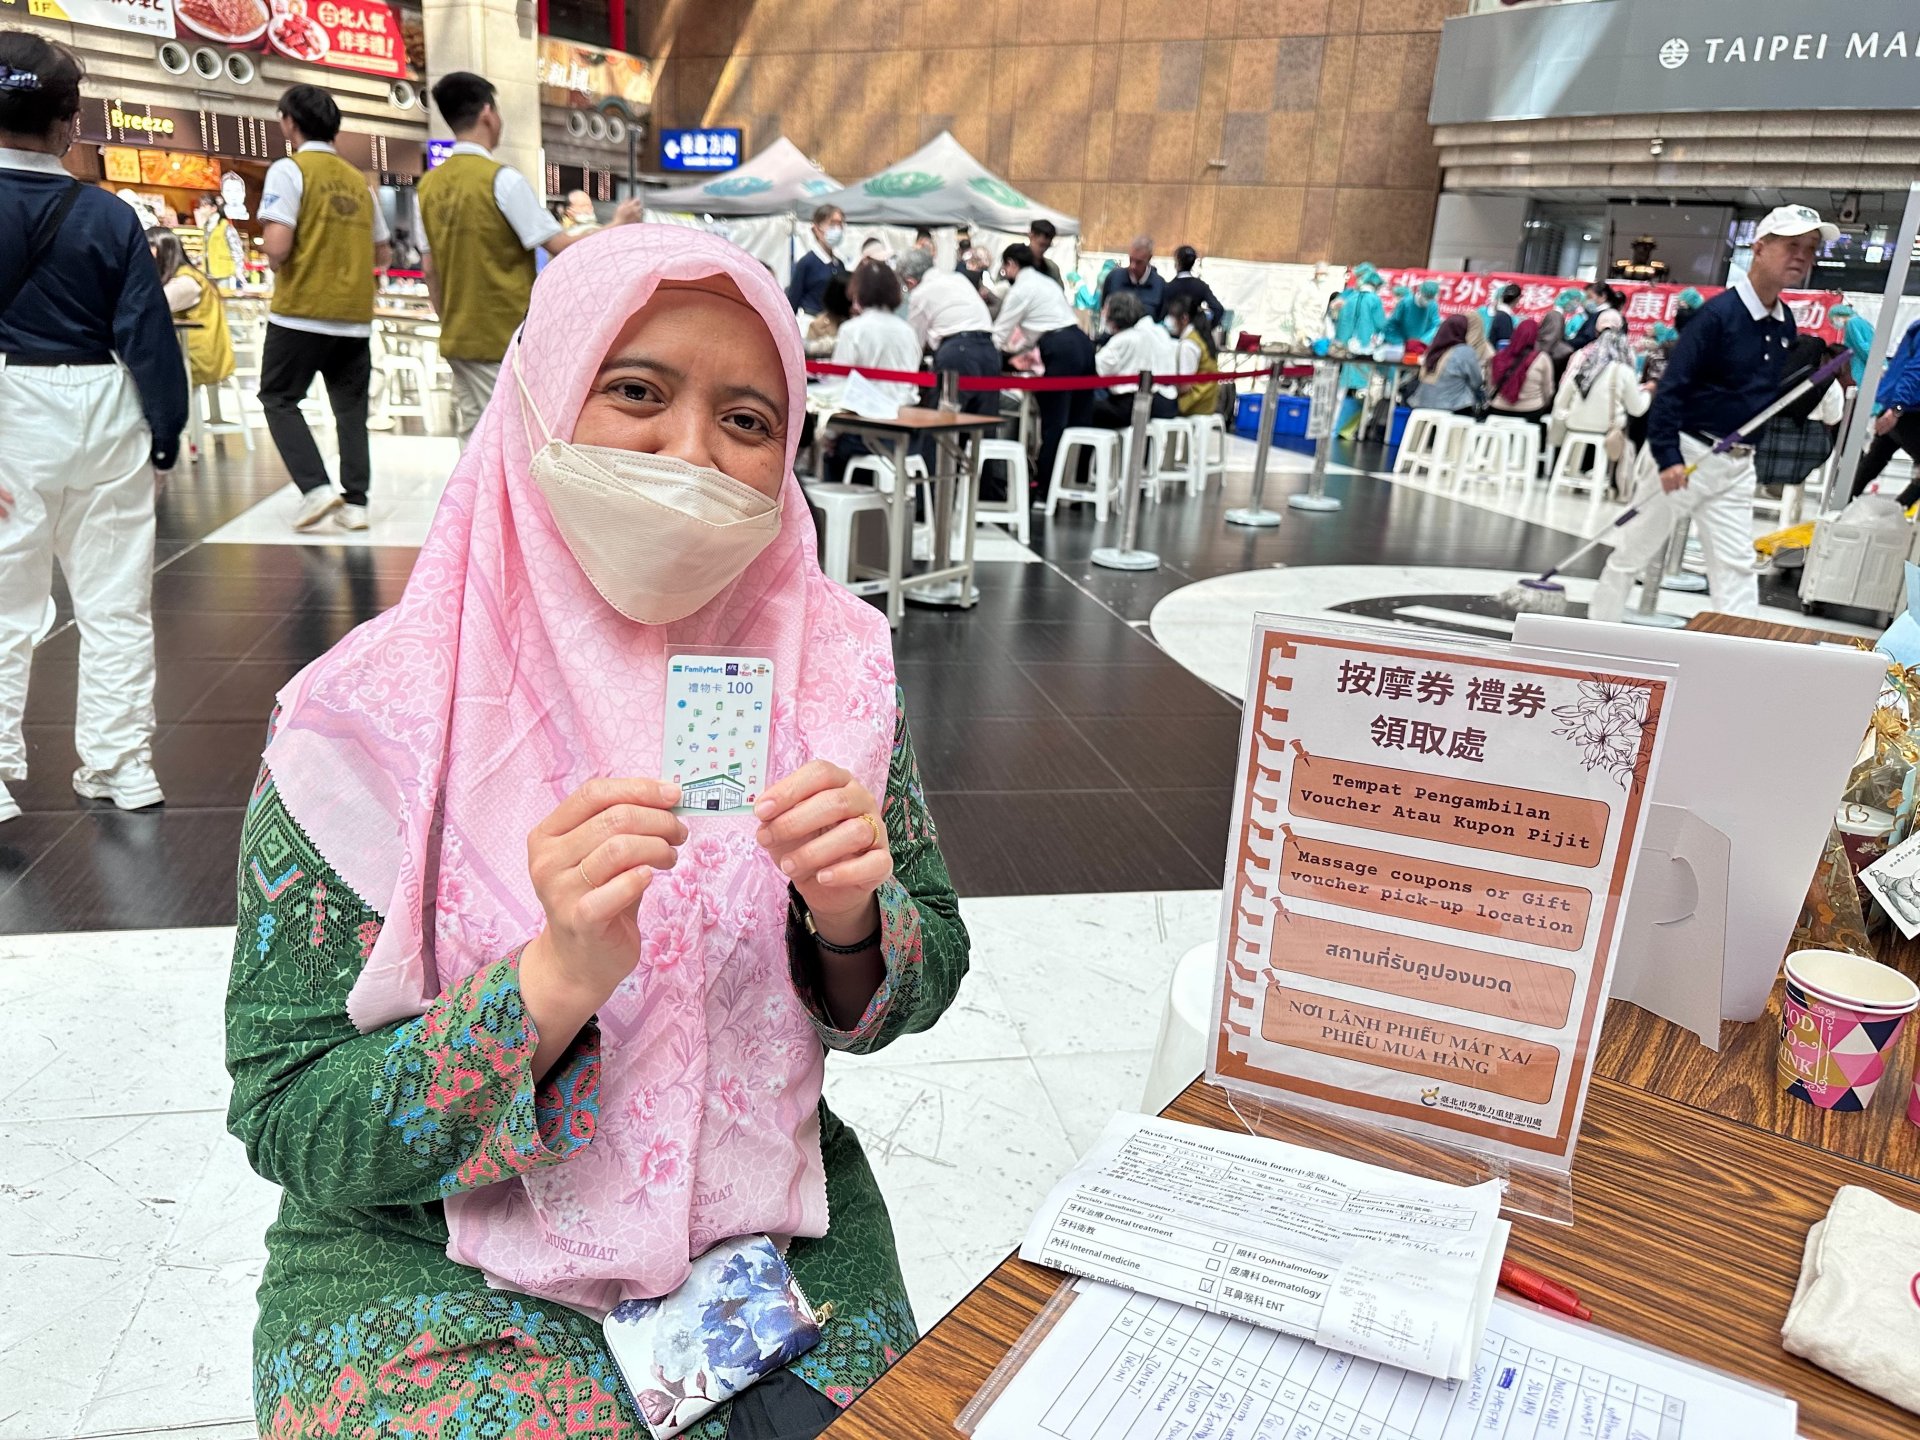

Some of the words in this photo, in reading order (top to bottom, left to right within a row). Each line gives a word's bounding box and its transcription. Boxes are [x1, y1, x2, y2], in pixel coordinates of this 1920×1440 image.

[1704, 33, 1828, 63] TAIPEI
[110, 108, 174, 134] Breeze
[684, 665, 723, 674] FamilyMart
[688, 682, 723, 693] 禮物卡
[726, 681, 754, 694] 100
[1336, 659, 1455, 706] 按摩券
[1465, 676, 1547, 718] 禮券
[1370, 714, 1488, 763] 領取處
[1332, 774, 1402, 795] Tempat
[1414, 787, 1551, 821] Pengambilan
[1300, 789, 1381, 813] Voucher
[1392, 805, 1441, 824] Atau
[1453, 815, 1515, 836] Kupon
[1527, 828, 1590, 849] Pijit
[1297, 850, 1378, 876] Massage
[1390, 870, 1472, 893] coupons
[1485, 887, 1510, 900] or
[1522, 892, 1571, 911] Gift
[1290, 871, 1370, 895] voucher
[1380, 888, 1463, 915] pick-up
[1476, 904, 1573, 934] location
[1325, 943, 1512, 993] สถานที่รับคูปองนวด
[1288, 1000, 1323, 1019] NƠI
[1327, 1009, 1381, 1032] LÃNH
[1448, 1035, 1495, 1057] MÁT
[1497, 1047, 1533, 1065] XA/
[1382, 1039, 1426, 1061] MUA
[1432, 1051, 1489, 1074] HÀNG
[1440, 1095, 1542, 1127] 臺北市勞動力重建運用處
[1139, 1128, 1173, 1141] Physical
[1174, 1137, 1196, 1147] exam
[1198, 1143, 1215, 1152] and
[1216, 1149, 1268, 1166] consultation
[1331, 1178, 1347, 1188] Date
[1076, 1193, 1102, 1206] Specialty
[1103, 1201, 1145, 1216] consultation:
[1314, 1186, 1338, 1198] female
[1067, 1202, 1104, 1219] 牙科治療
[1104, 1214, 1131, 1227] Dental
[1132, 1219, 1174, 1238] treatment
[545, 1230, 619, 1262] MUSLIMAT
[1050, 1236, 1070, 1250] 內科
[1070, 1238, 1102, 1258] Internal
[1102, 1250, 1141, 1270] medicine
[1063, 1263, 1096, 1280] Chinese
[1258, 1255, 1329, 1280] Ophthalmology
[1228, 1266, 1260, 1281] 皮膚科
[1261, 1275, 1322, 1300] Dermatology
[1265, 1299, 1285, 1312] ENT
[1121, 1317, 1134, 1327] 20
[1144, 1327, 1156, 1337] 19
[1165, 1337, 1178, 1347] 18
[1189, 1348, 1201, 1357] 17
[1211, 1357, 1224, 1367] 16
[1235, 1367, 1248, 1378] 15
[1260, 1378, 1272, 1389] 14
[1283, 1389, 1296, 1400] 13
[1308, 1400, 1321, 1412] 12
[1333, 1412, 1347, 1423] 11
[1359, 1424, 1372, 1435] 10
